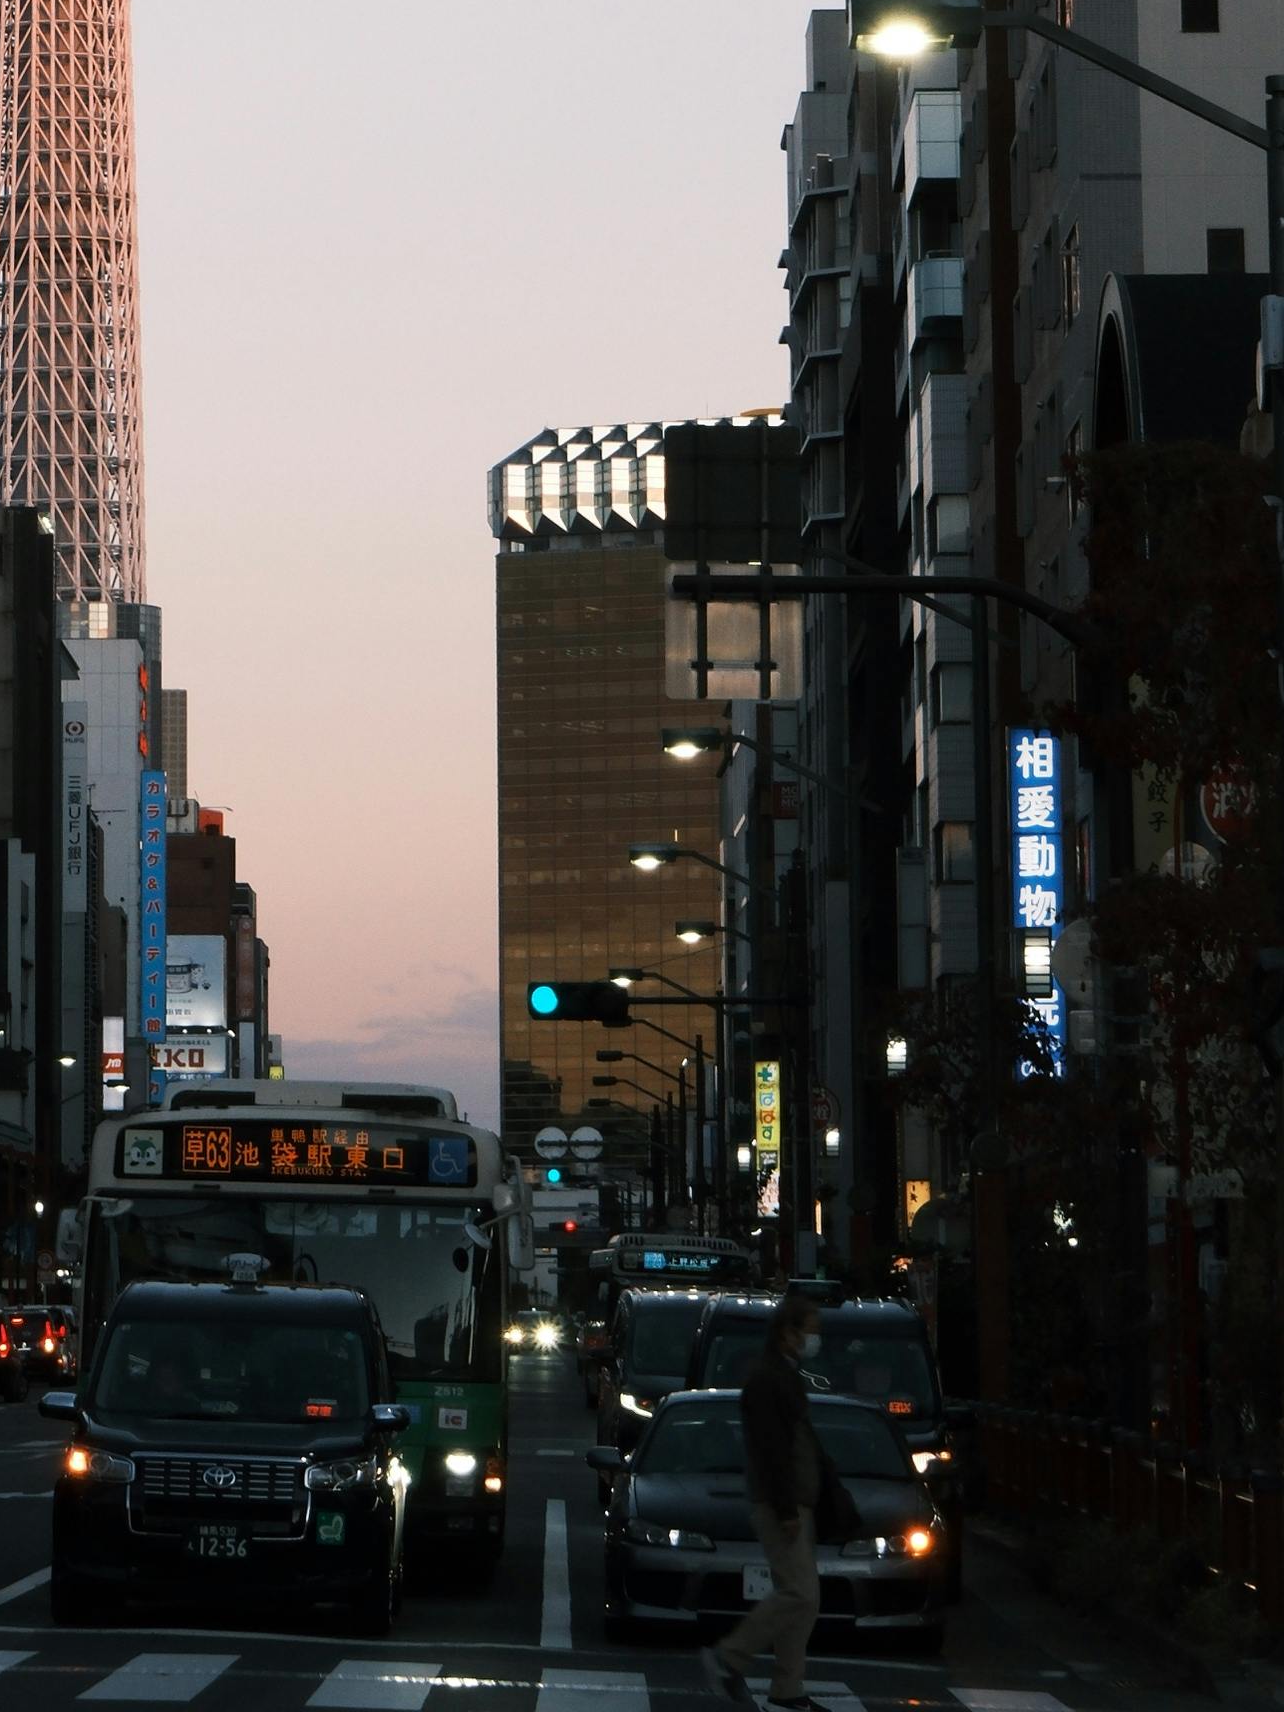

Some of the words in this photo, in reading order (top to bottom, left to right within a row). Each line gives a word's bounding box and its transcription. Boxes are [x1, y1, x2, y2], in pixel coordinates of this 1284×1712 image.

[68, 776, 82, 876] 三菱UFJ銀行
[1016, 736, 1059, 1026] 相愛動物
[186, 1129, 229, 1168] 草63
[271, 1128, 370, 1145] 巣鴨駅経由
[235, 1141, 404, 1169] 池袋駅東口
[271, 1167, 334, 1176] IKEBUKURO
